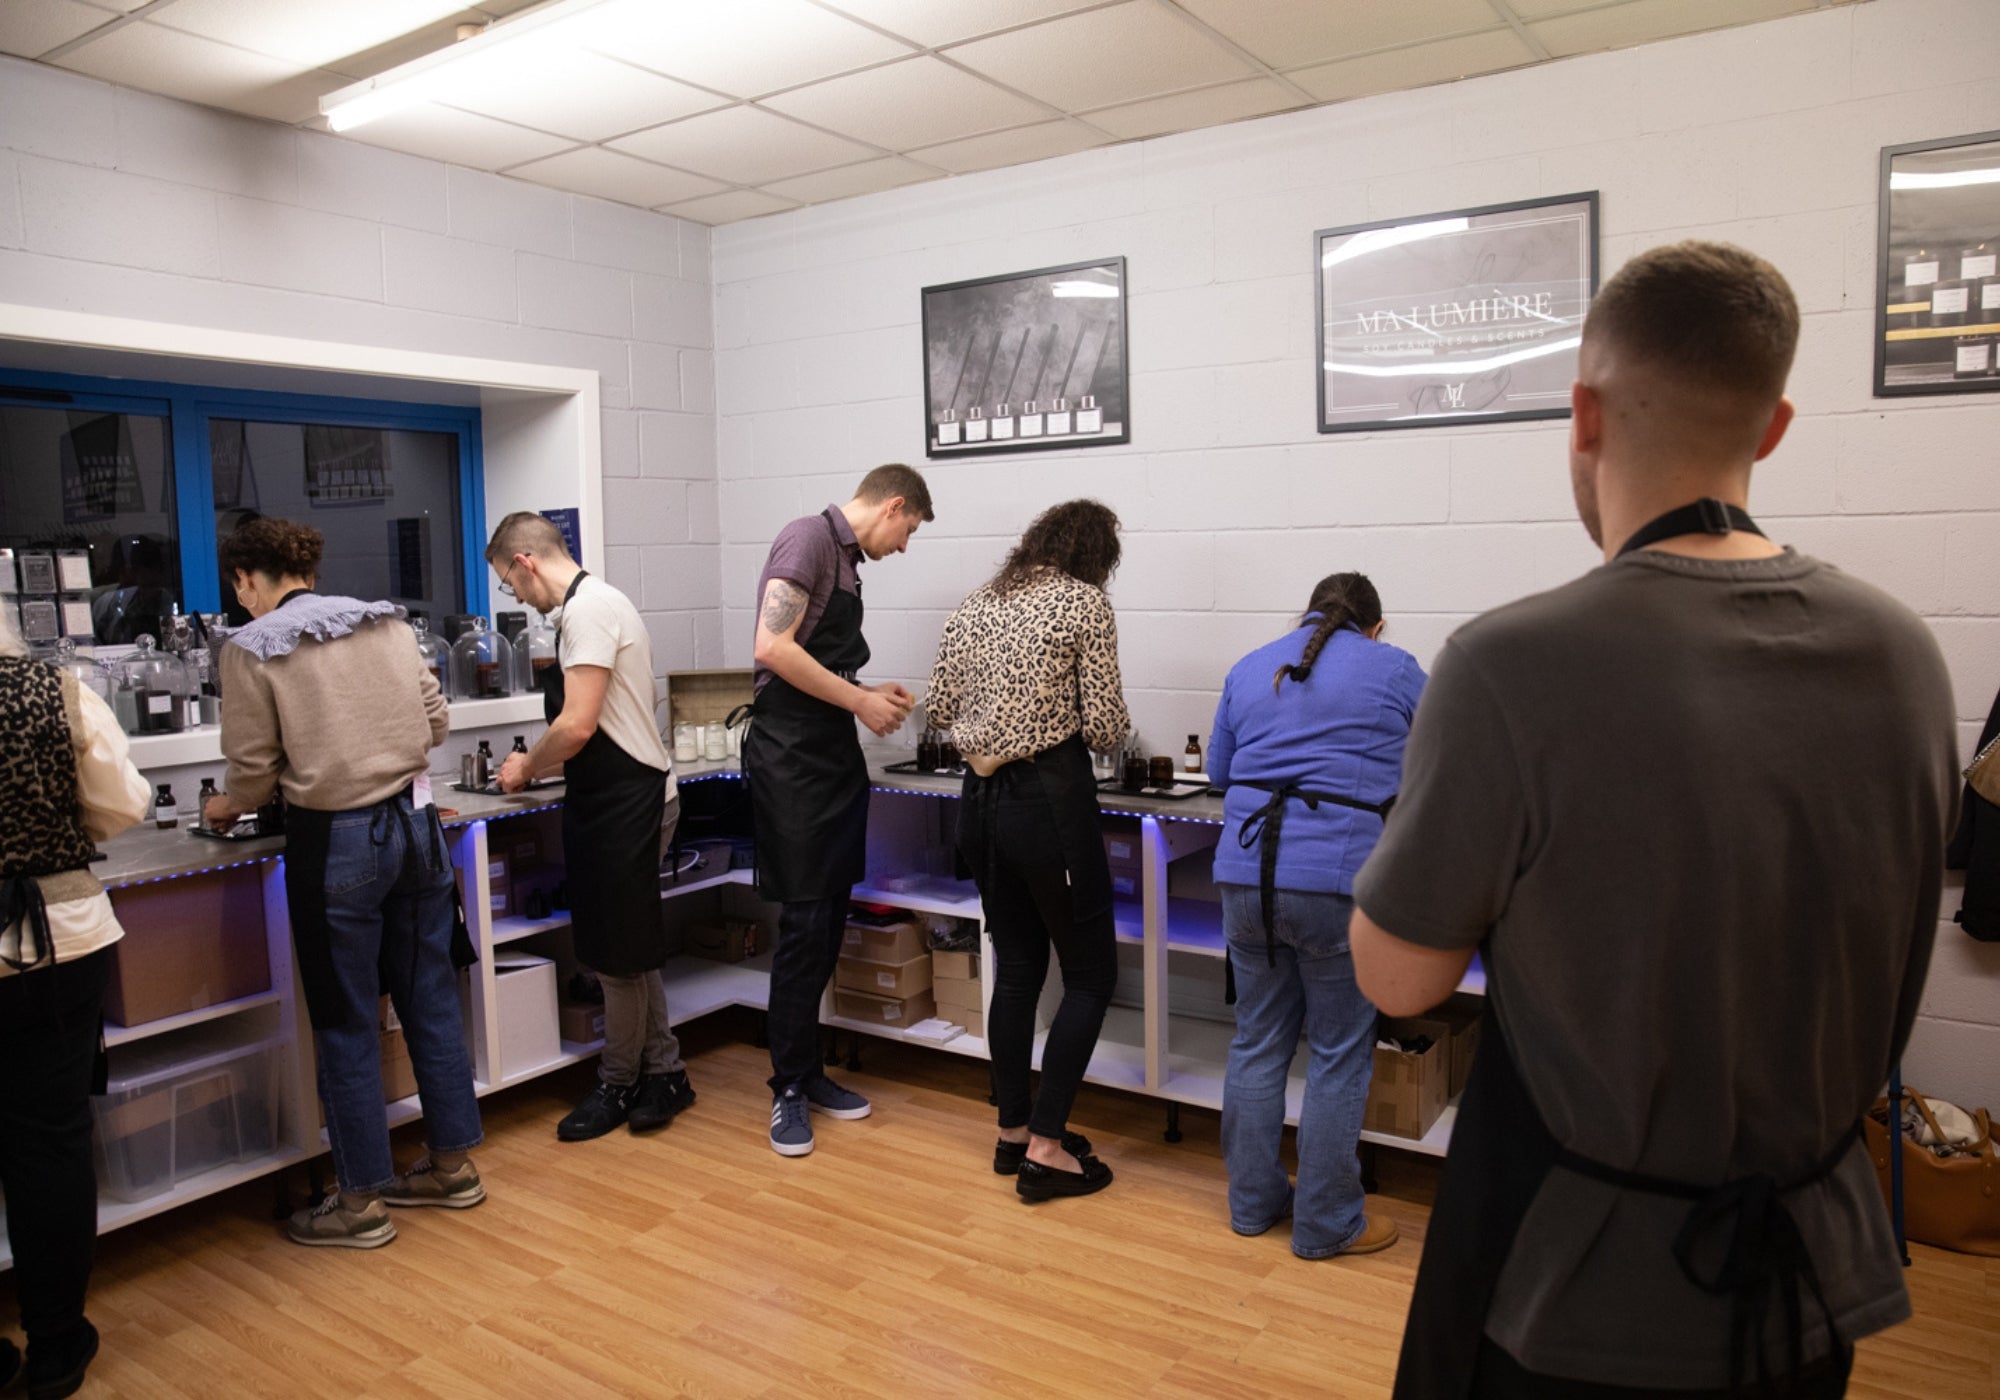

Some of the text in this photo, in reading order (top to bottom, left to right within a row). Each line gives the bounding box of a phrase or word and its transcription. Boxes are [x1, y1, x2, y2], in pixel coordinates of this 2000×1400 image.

[1357, 289, 1552, 335] MA LUMIÈRE
[1397, 336, 1463, 350] CANDLES
[1471, 336, 1479, 344] &
[1487, 328, 1545, 342] SCENTS
